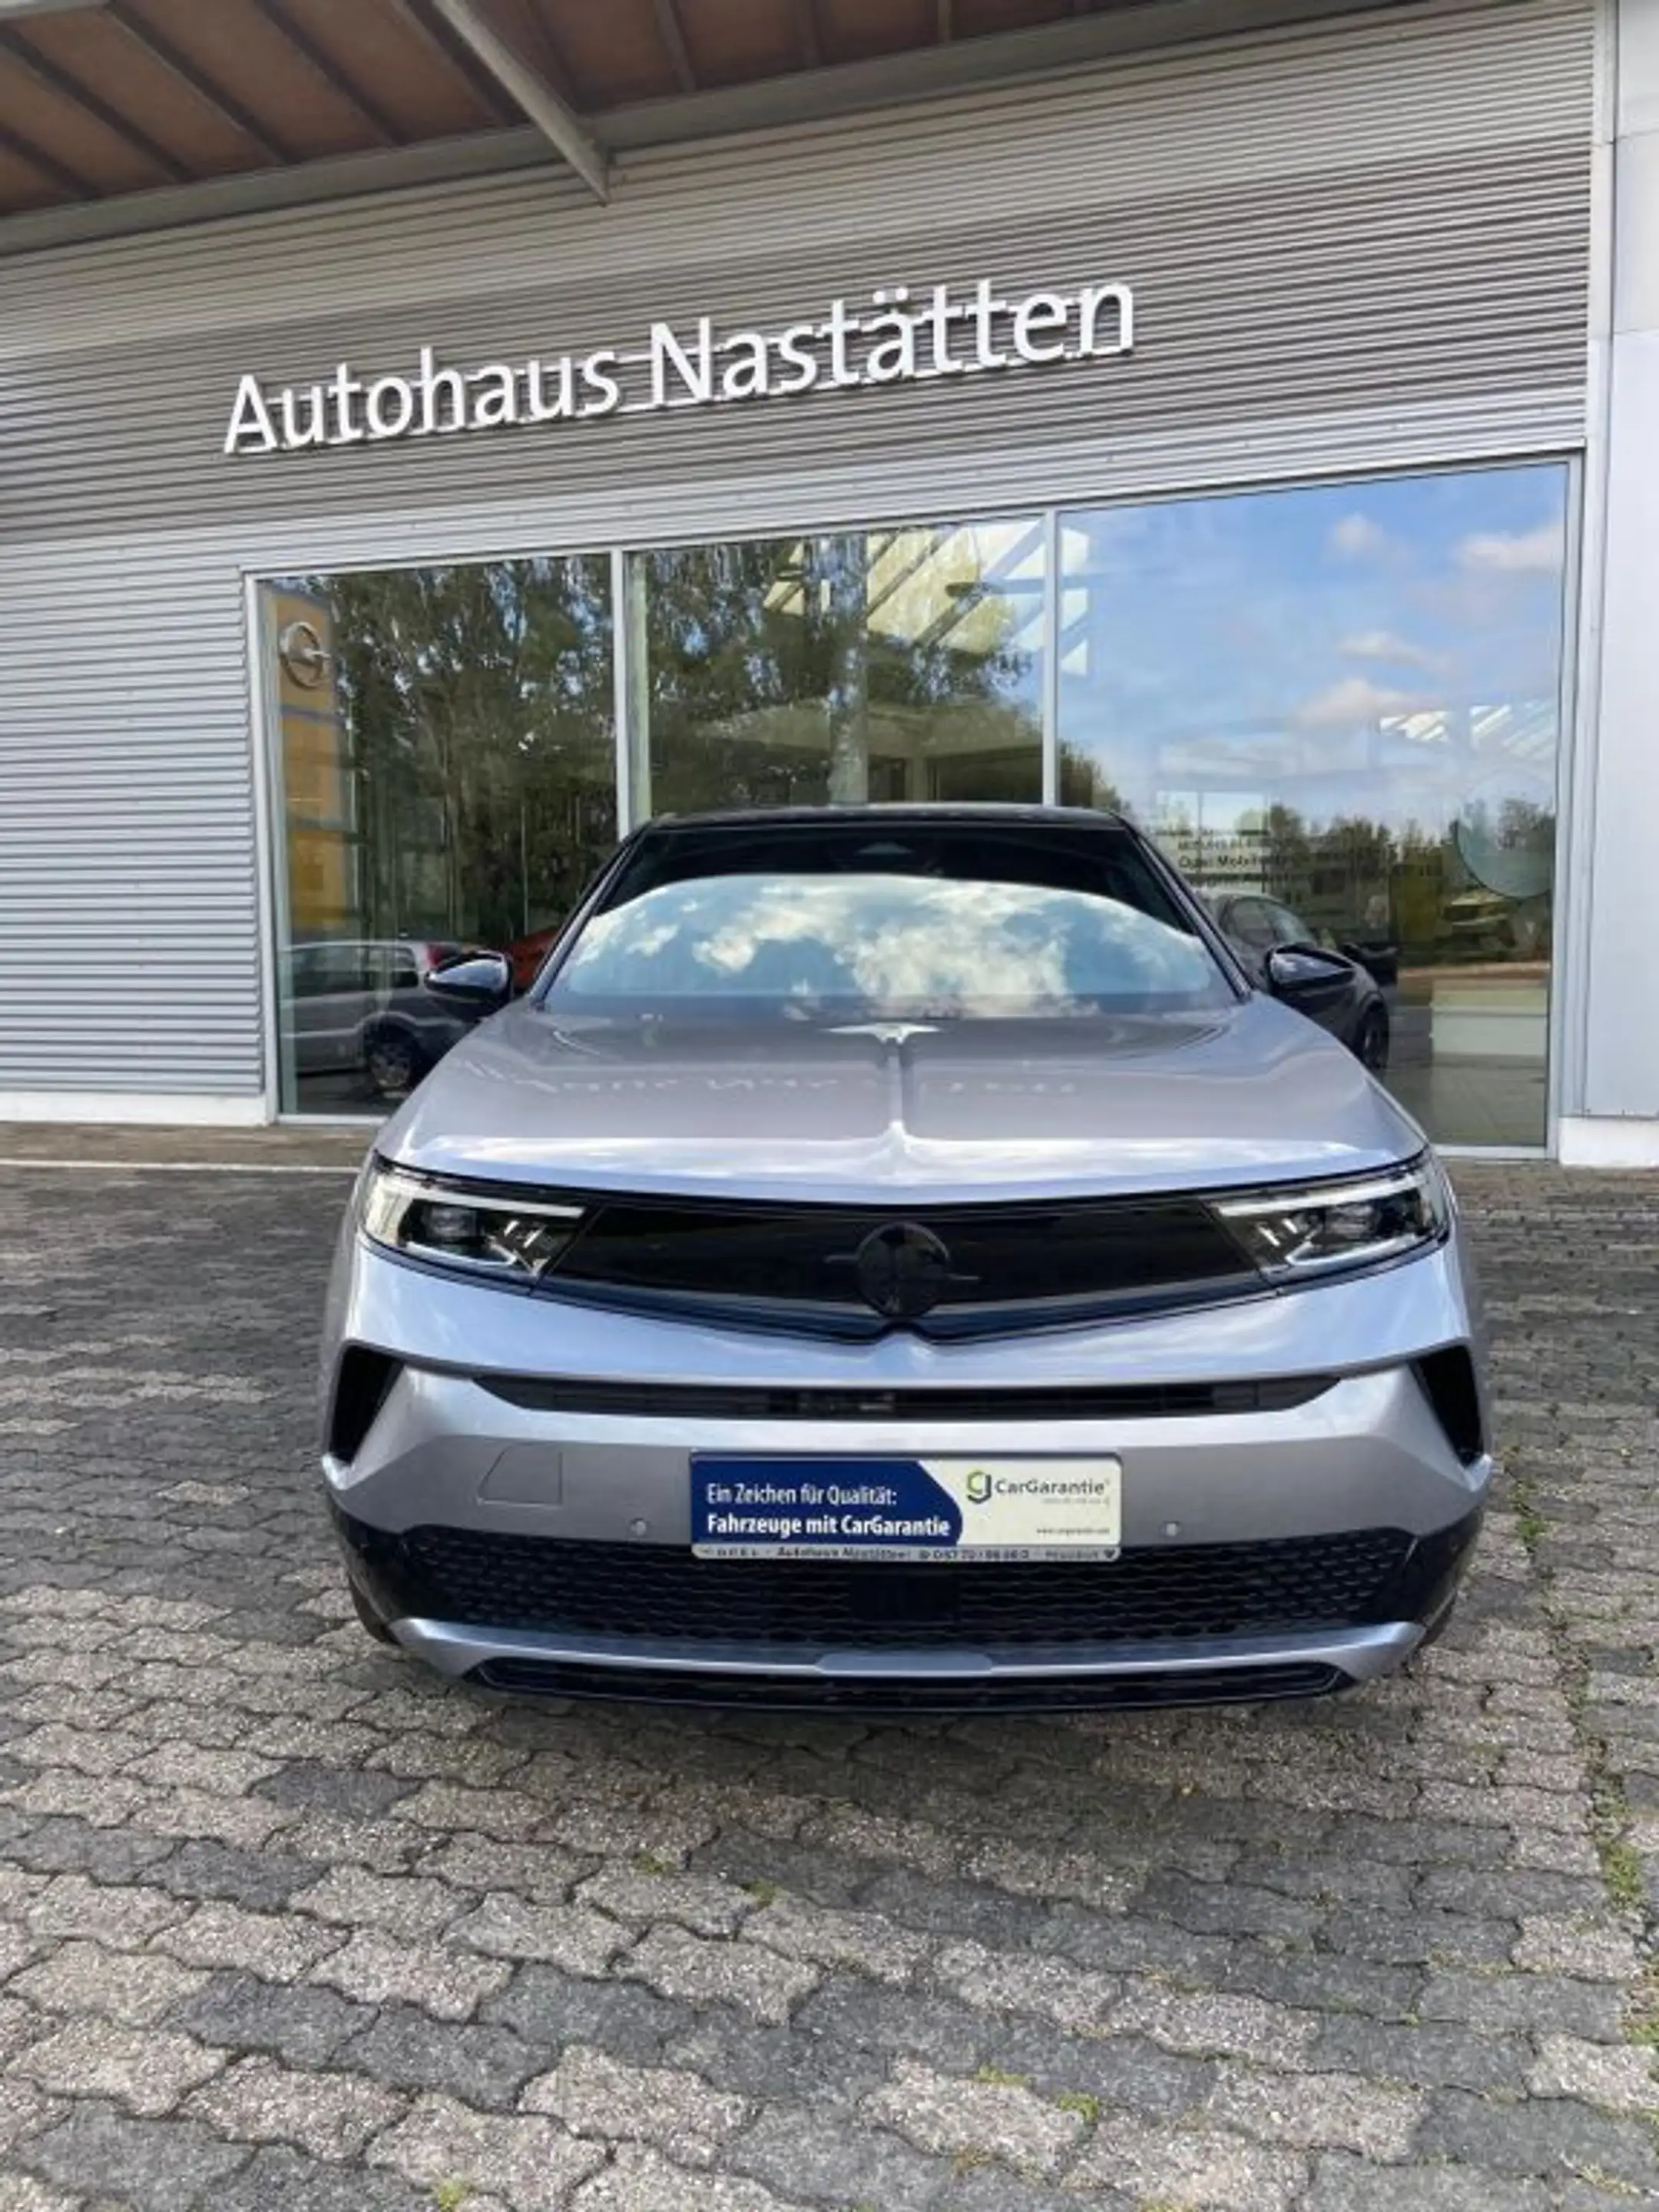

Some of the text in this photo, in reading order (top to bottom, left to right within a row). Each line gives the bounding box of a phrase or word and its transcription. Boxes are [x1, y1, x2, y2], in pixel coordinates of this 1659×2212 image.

[224, 279, 1134, 454] Autohaus Nastätten
[707, 1483, 897, 1506] Ein Zeichen für Qualität:
[995, 1478, 1105, 1495] CarGarantie
[707, 1512, 951, 1538] Fahrzeuge mit CarGarantie
